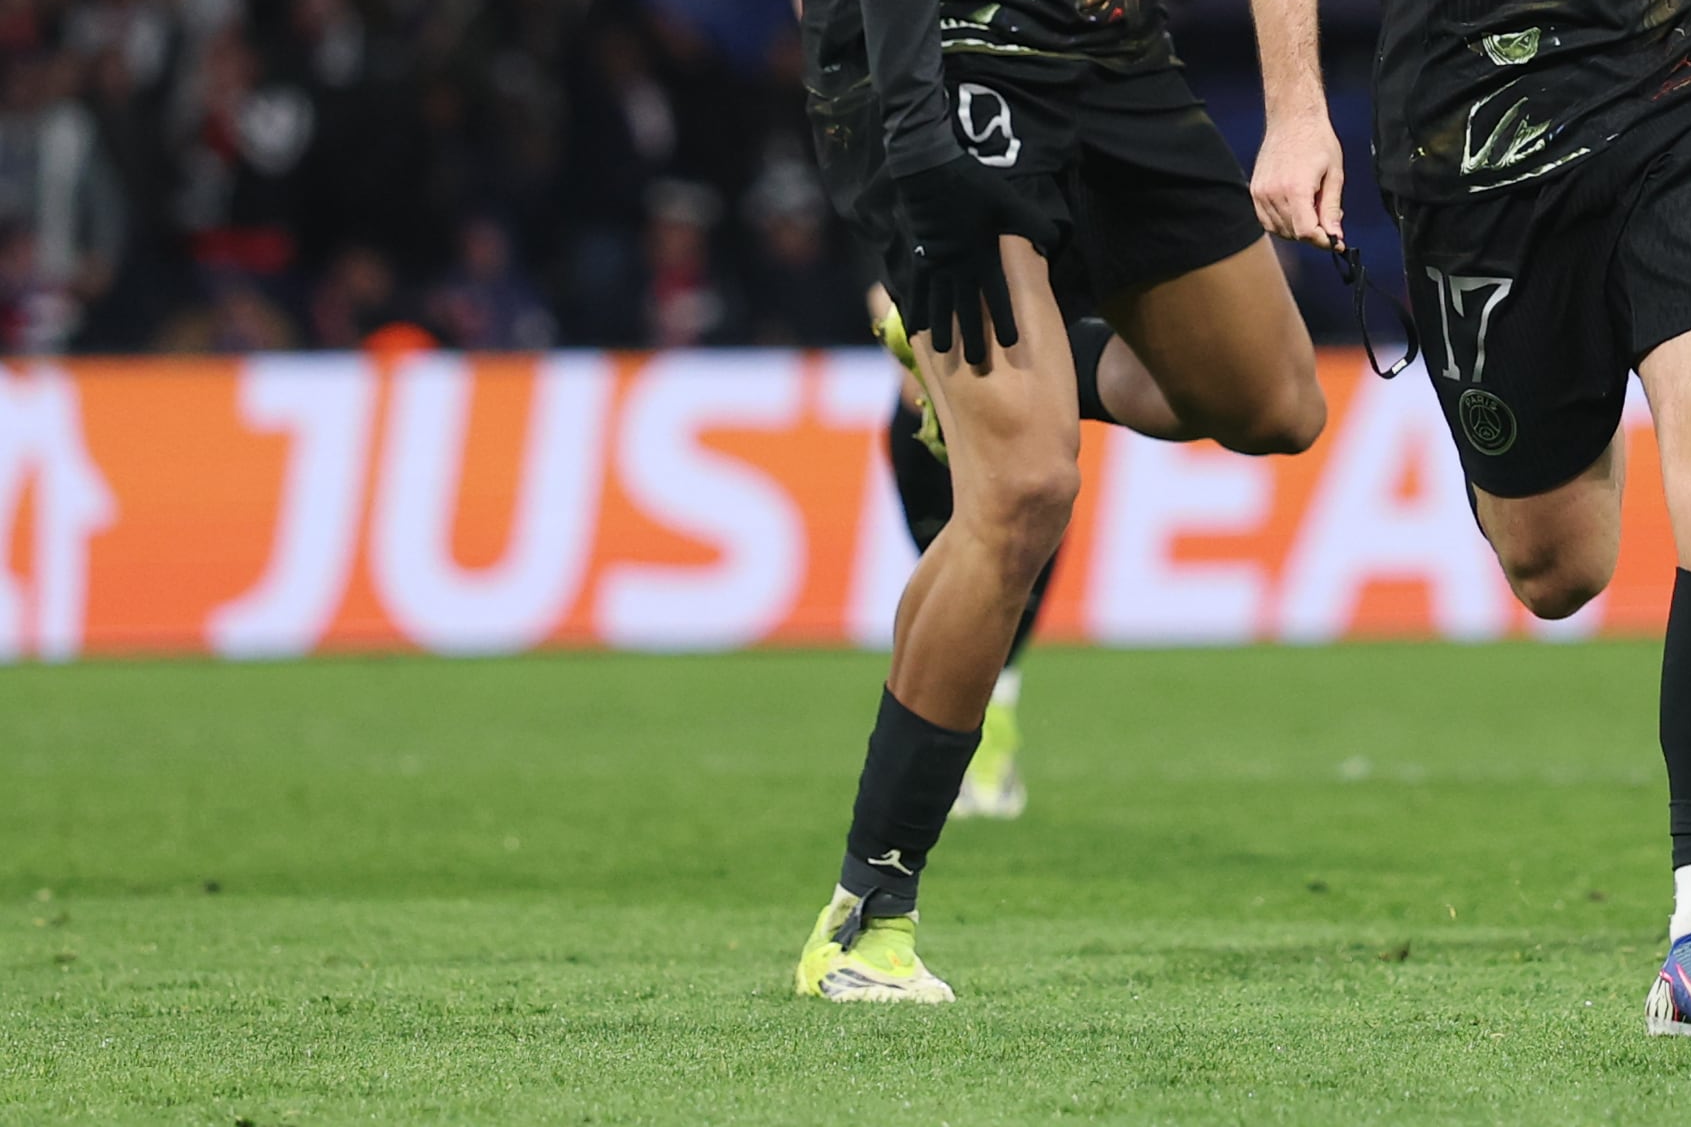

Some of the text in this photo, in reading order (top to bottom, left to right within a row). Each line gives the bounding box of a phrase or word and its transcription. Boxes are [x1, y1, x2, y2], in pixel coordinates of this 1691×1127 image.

[944, 82, 1021, 168] 9
[1425, 266, 1514, 383] 17
[1084, 346, 1646, 645] EA
